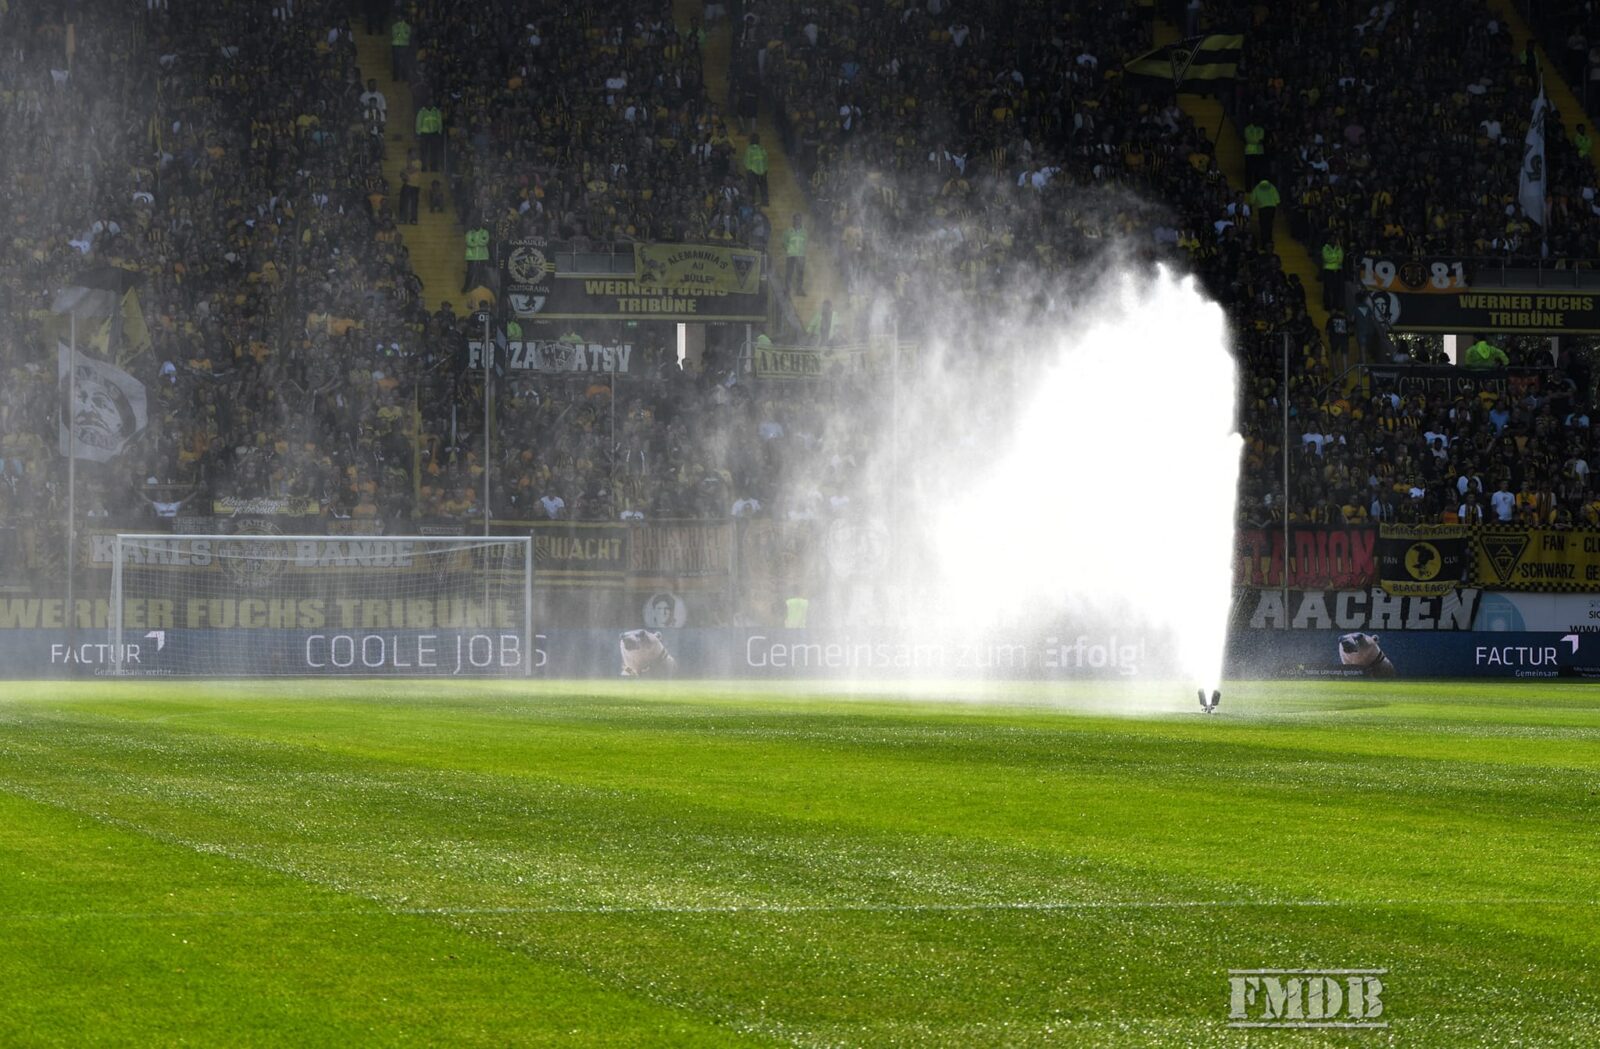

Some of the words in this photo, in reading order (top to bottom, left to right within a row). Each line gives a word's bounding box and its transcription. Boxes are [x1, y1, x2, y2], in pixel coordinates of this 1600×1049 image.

[618, 297, 696, 313] TRIBÜNE
[1459, 295, 1532, 310] WERNER
[1537, 297, 1594, 311] FUCHS
[1489, 310, 1565, 326] TRIBÜNE
[469, 341, 538, 369] FOZA
[573, 344, 632, 372] ATSV
[294, 540, 415, 567] BANDE
[1542, 535, 1565, 552] FAN
[1583, 536, 1600, 553] CL
[1237, 528, 1377, 586] TADION
[1383, 555, 1398, 565] FAN
[1443, 555, 1459, 565] CLU
[1521, 562, 1576, 580] SCHWARZ
[1392, 583, 1422, 592] BLACK
[0, 598, 174, 629] WERNER
[187, 598, 326, 629] FUCHS
[1250, 587, 1478, 630] AACHEN
[50, 644, 141, 664] FACTUR
[306, 635, 437, 667] COOLE
[453, 635, 547, 675] JOBS
[746, 635, 946, 668] Gemeinsam
[1475, 646, 1558, 666] FACTUR
[1514, 669, 1559, 678] Gemeinsam
